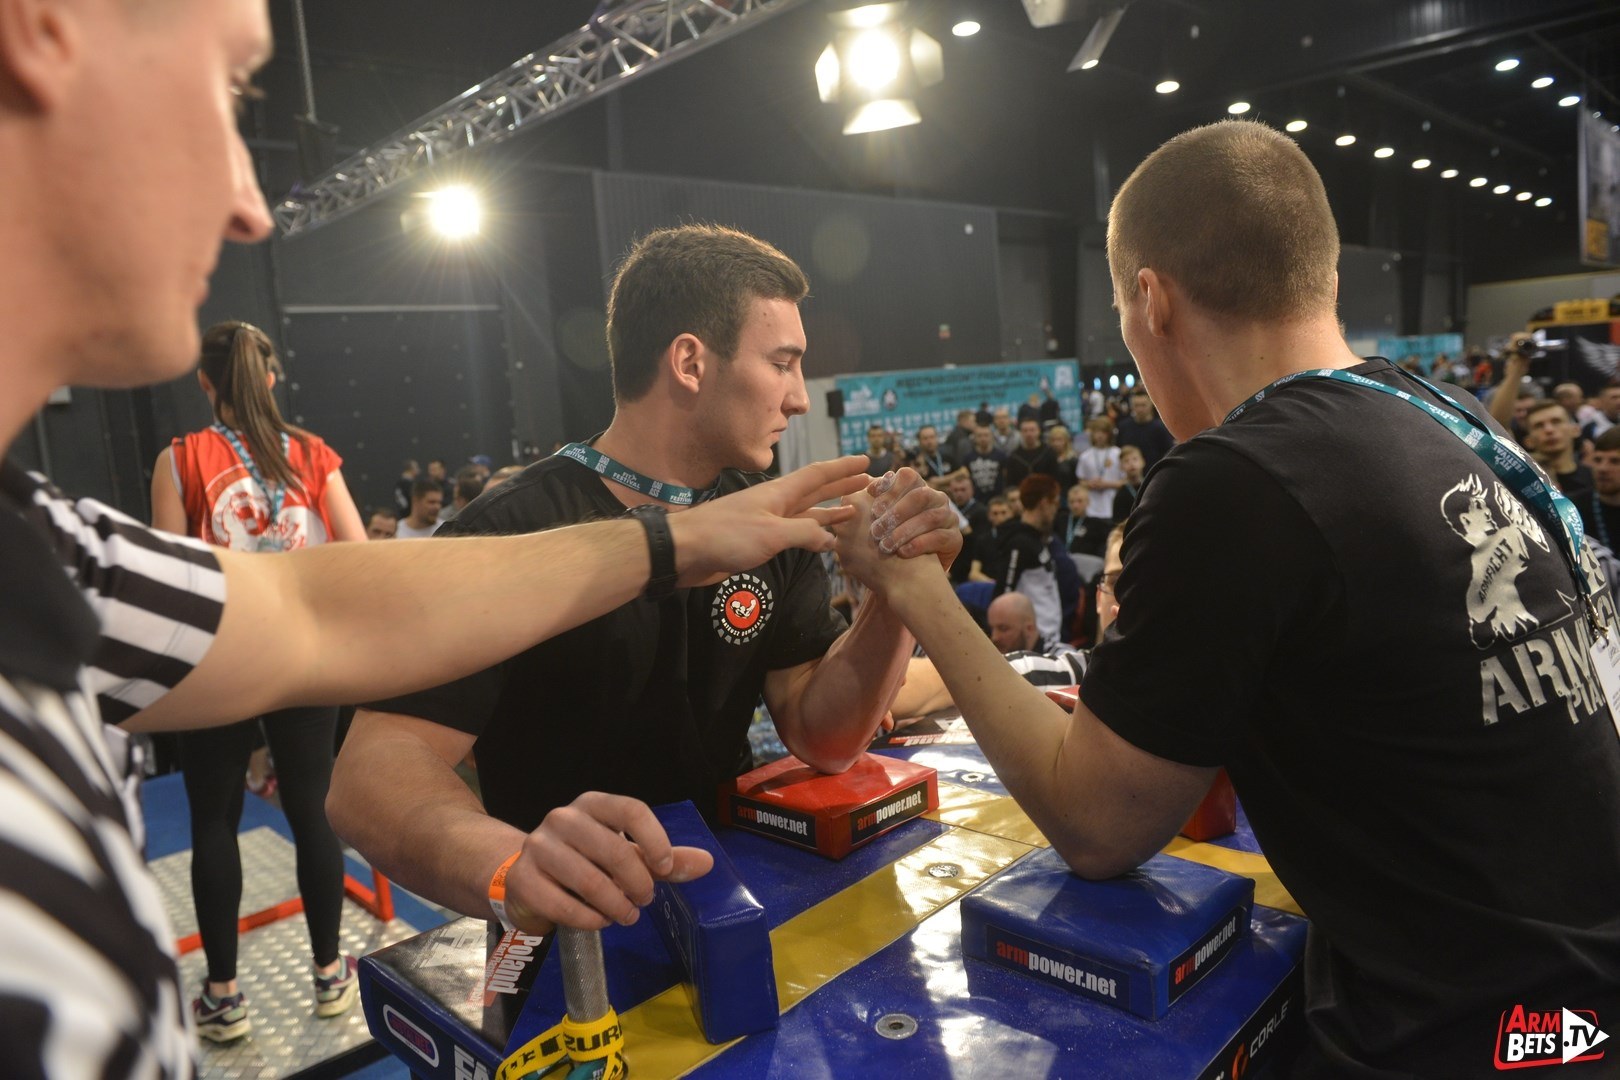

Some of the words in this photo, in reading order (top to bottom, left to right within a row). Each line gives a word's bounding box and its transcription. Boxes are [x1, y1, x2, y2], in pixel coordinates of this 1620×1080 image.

[1493, 441, 1526, 473] FESTIVAL
[612, 472, 640, 489] FESTIVAL
[737, 804, 808, 836] armpower.net
[857, 790, 922, 831] armpower.net
[486, 936, 544, 995] Poland
[995, 940, 1117, 999] armpower.net
[1174, 915, 1237, 985] armpower.net
